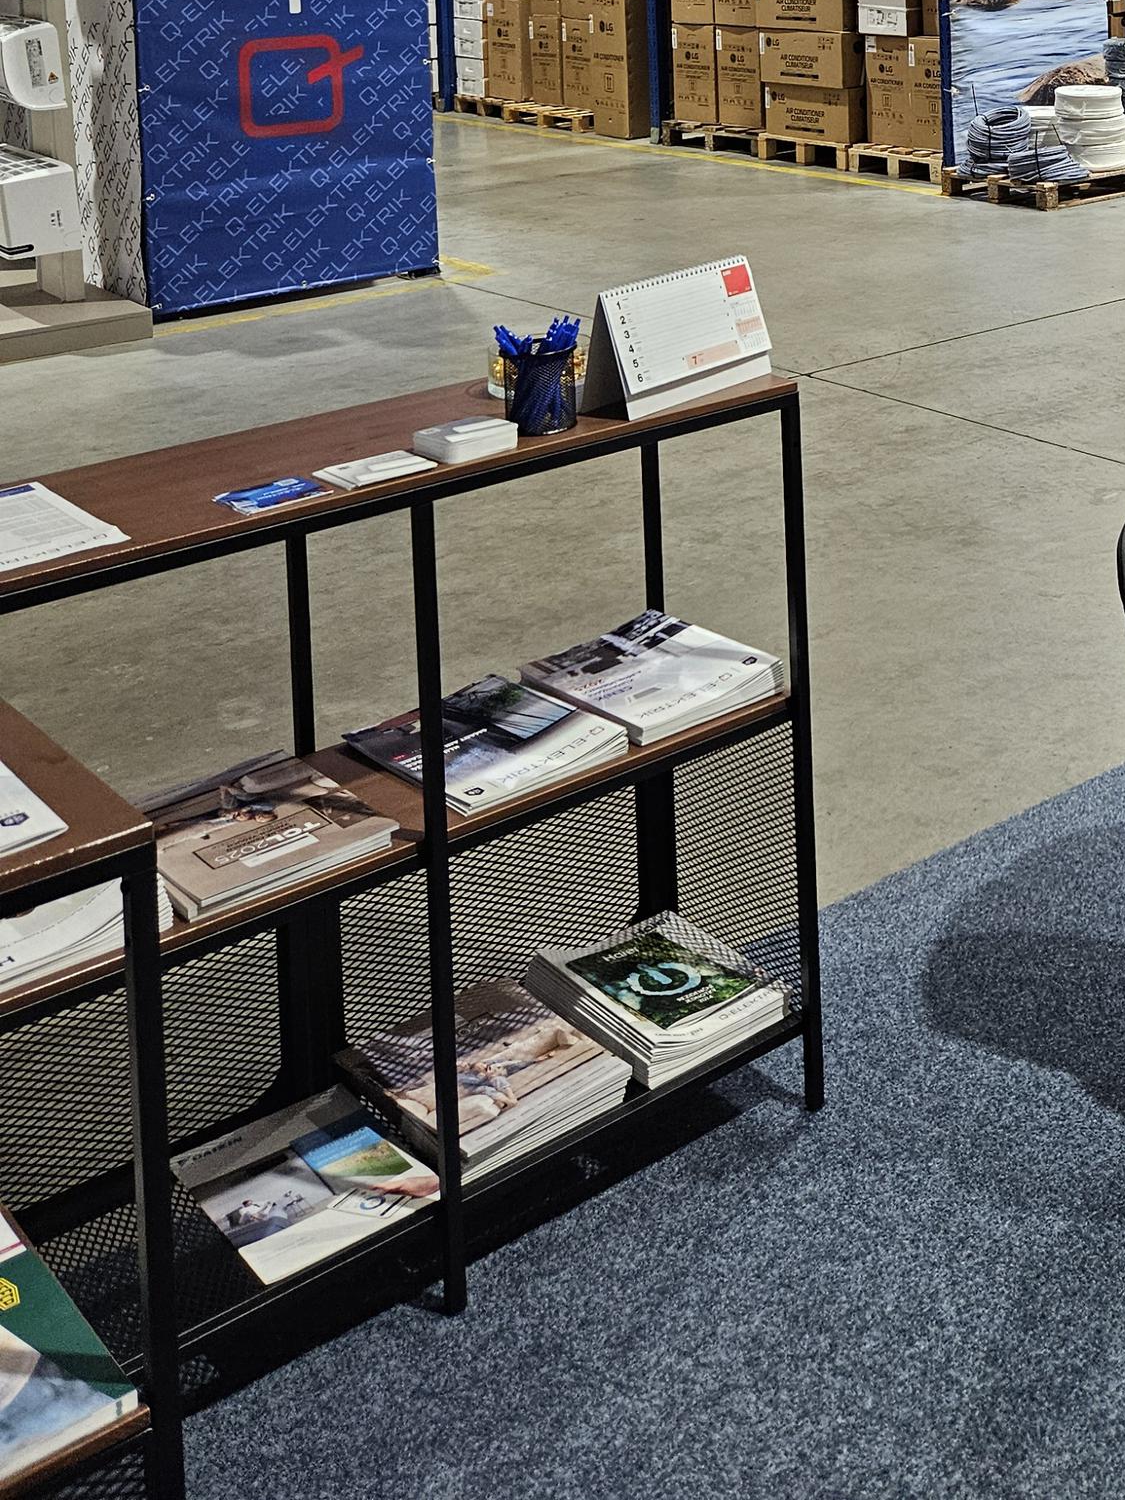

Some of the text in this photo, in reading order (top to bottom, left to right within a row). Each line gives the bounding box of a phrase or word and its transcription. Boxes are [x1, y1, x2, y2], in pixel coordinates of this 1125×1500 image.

[606, 23, 613, 32] LG
[772, 38, 780, 46] LG
[692, 52, 699, 61] LG
[737, 54, 744, 63] LG
[790, 55, 819, 63] CONDITIONER
[778, 92, 785, 100] LG
[796, 109, 825, 117] CONDITIONER
[311, 80, 423, 189] Q-ELEKTRIK
[262, 153, 379, 273] Q-ELEKTRIK
[616, 301, 622, 310] 1
[620, 316, 626, 325] 2
[624, 330, 630, 338] 3
[629, 345, 634, 353] 4
[633, 359, 639, 368] 5
[692, 356, 698, 365] 7
[638, 373, 643, 382] 6
[602, 947, 640, 962] Haier
